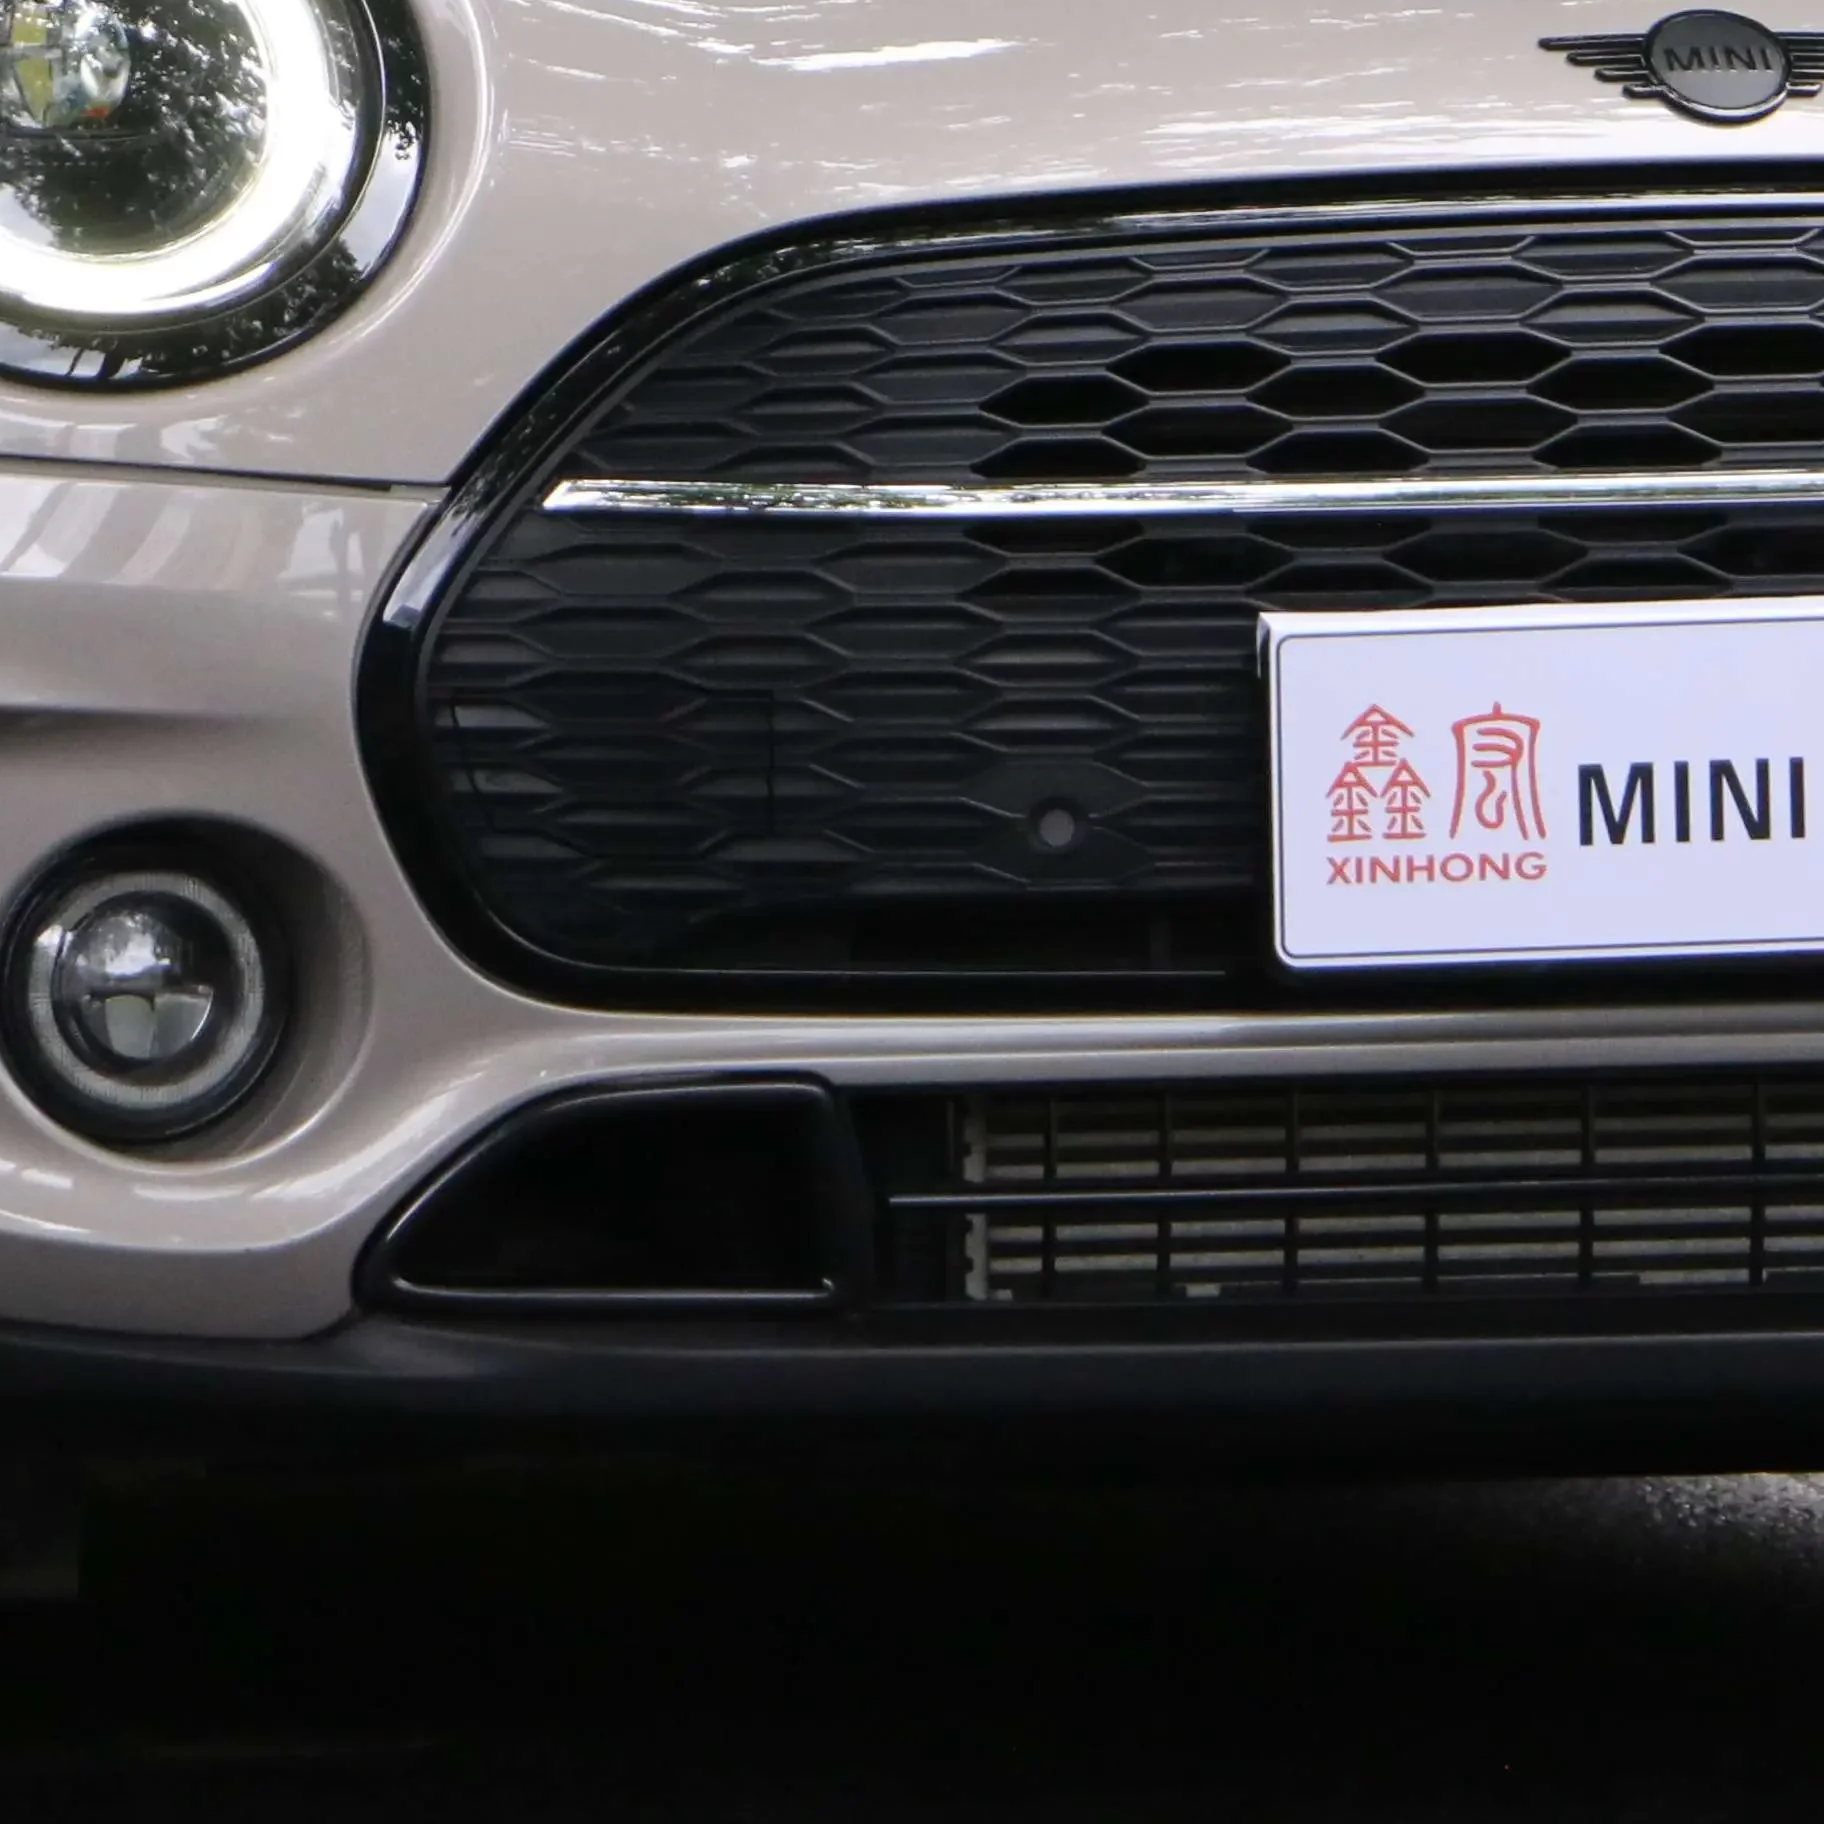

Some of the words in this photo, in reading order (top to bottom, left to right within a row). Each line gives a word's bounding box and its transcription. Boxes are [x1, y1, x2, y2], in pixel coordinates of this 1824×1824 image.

[1663, 46, 1774, 73] MINI
[1578, 756, 1806, 847] MINI
[1326, 851, 1548, 885] XINHONG
